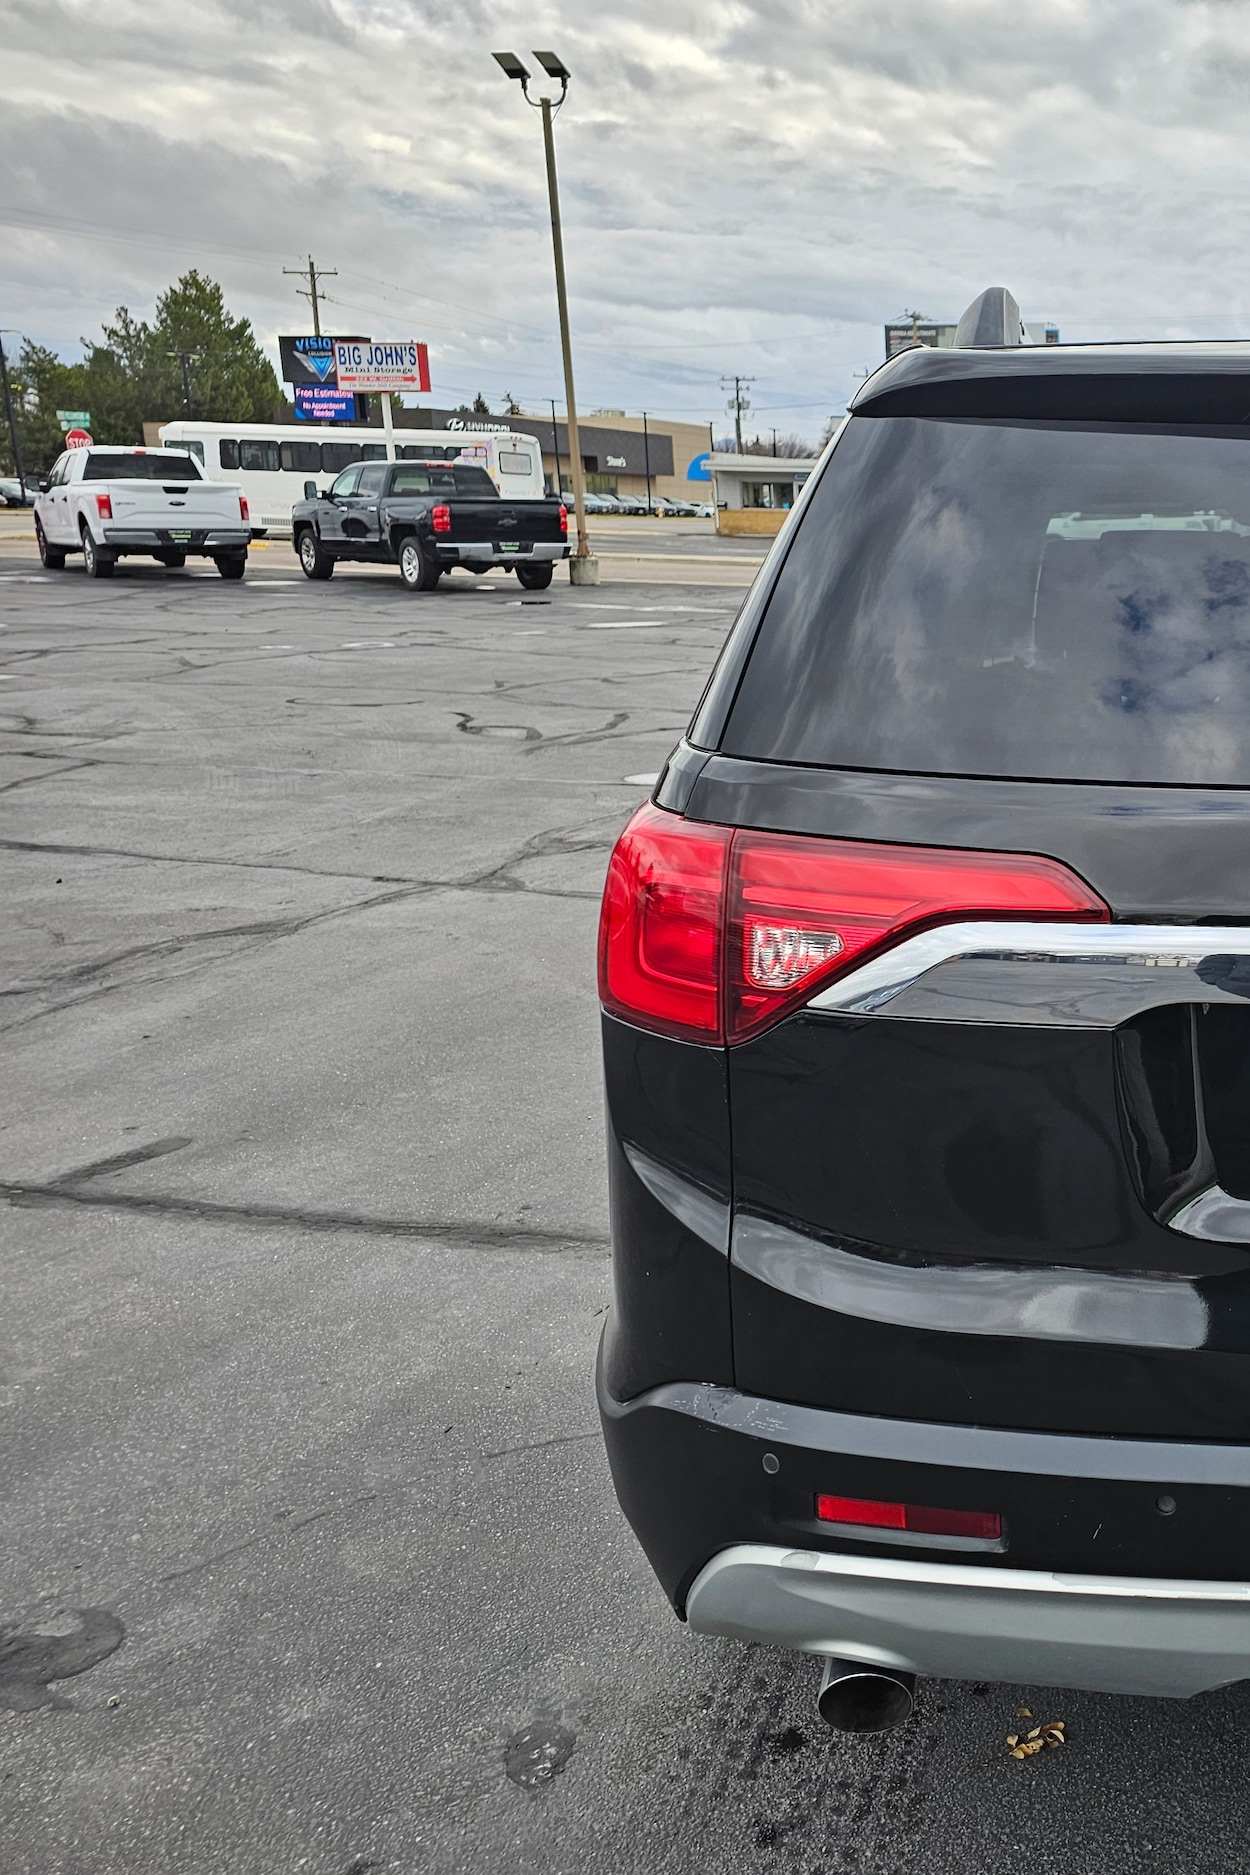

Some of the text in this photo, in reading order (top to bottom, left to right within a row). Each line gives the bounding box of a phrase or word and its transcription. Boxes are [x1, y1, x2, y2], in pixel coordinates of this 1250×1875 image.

[337, 345, 417, 366] BIG JOHN'S
[374, 366, 413, 375] Storage
[295, 387, 314, 398] Free
[302, 401, 346, 410] No Appointment
[68, 437, 91, 448] STOP
